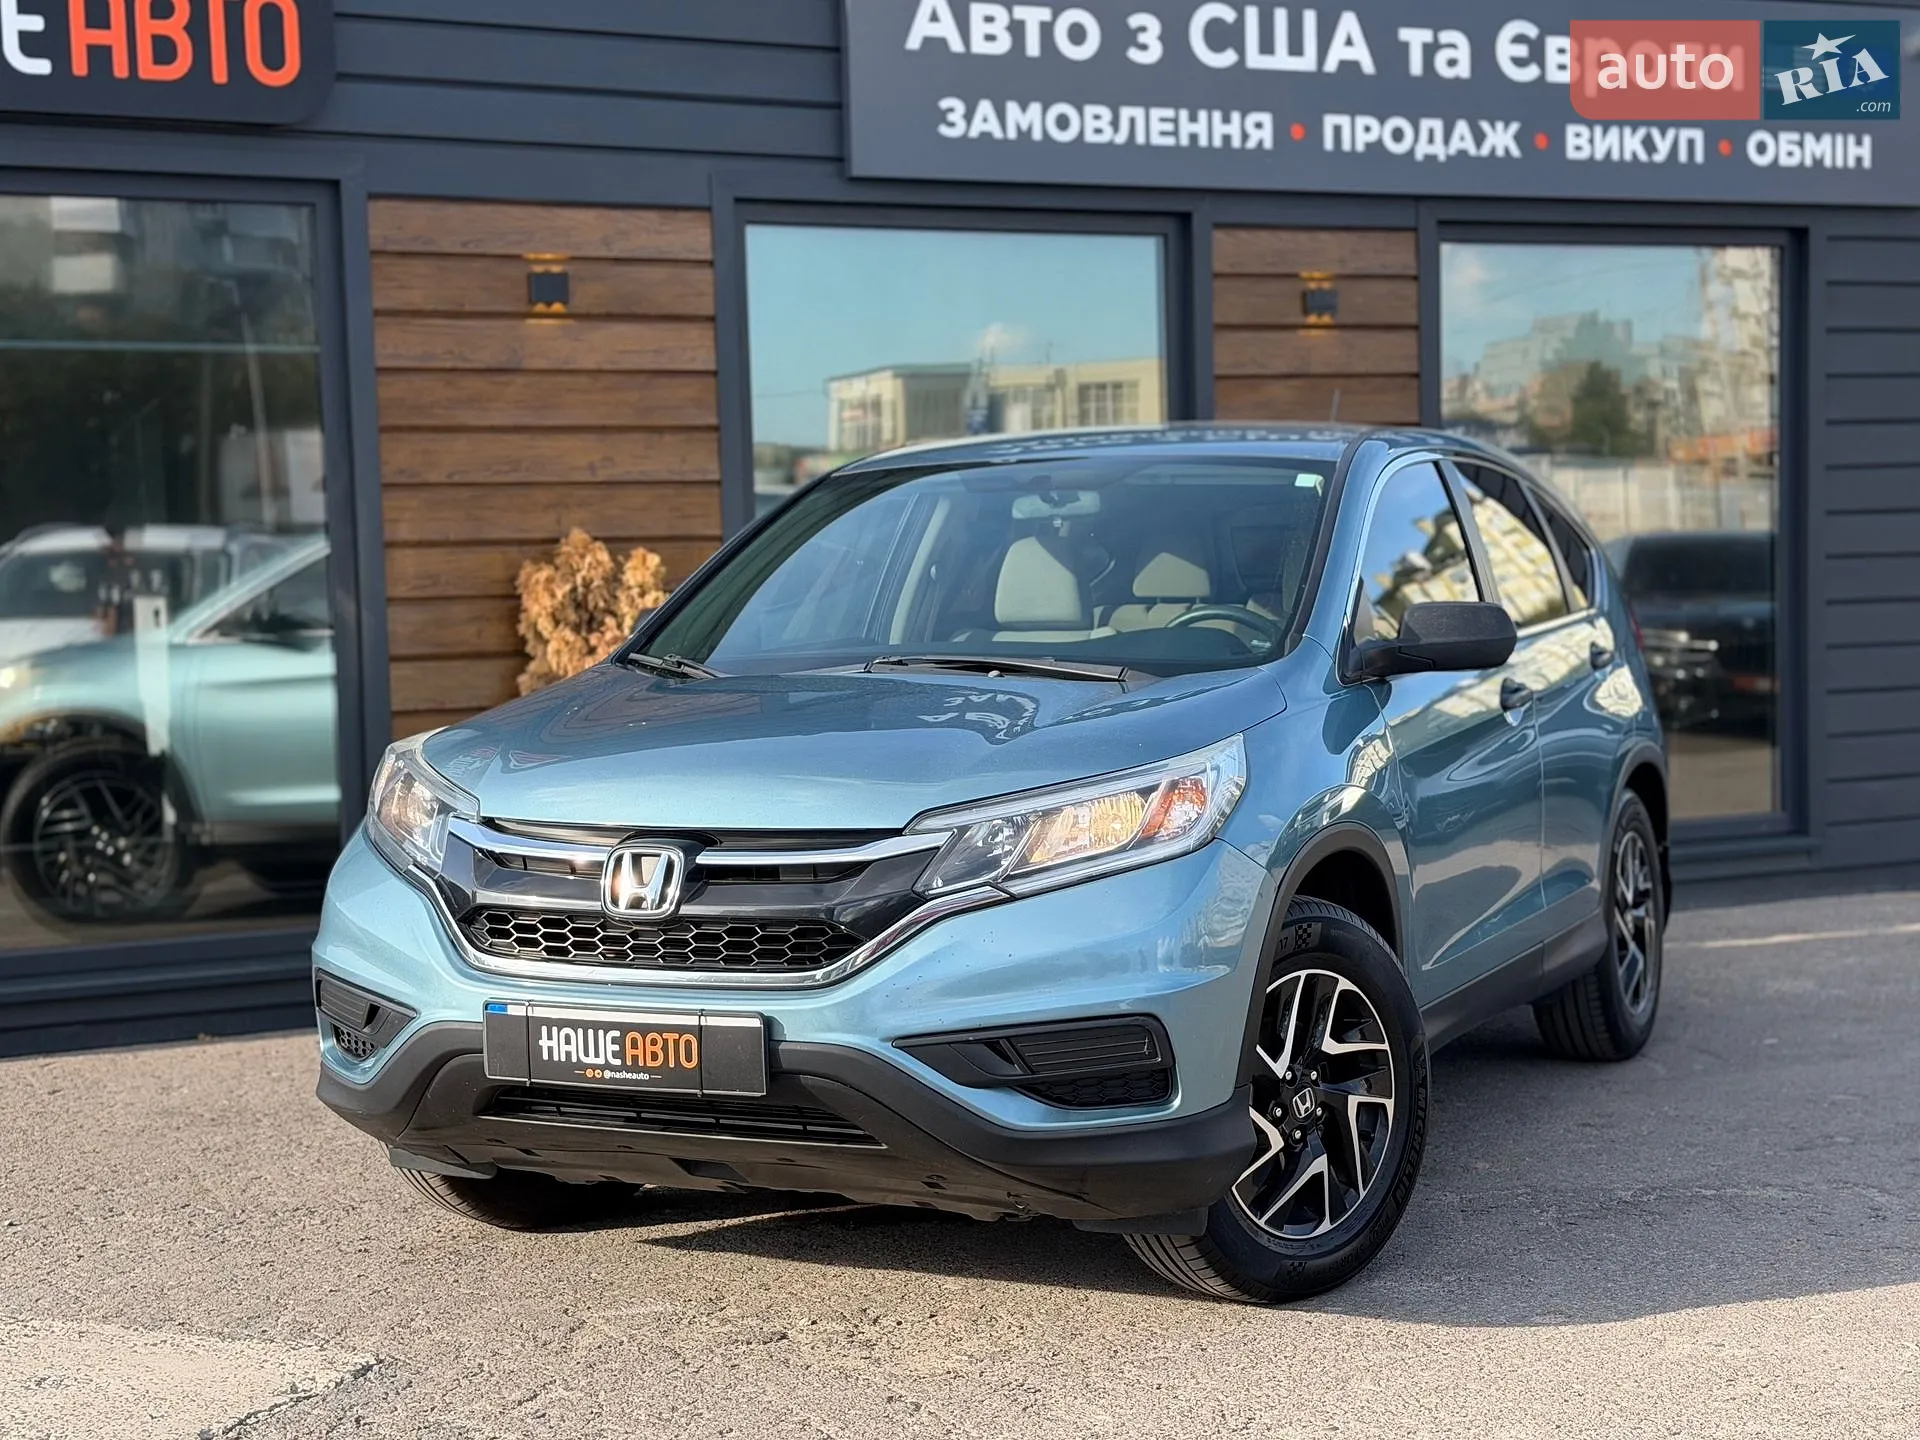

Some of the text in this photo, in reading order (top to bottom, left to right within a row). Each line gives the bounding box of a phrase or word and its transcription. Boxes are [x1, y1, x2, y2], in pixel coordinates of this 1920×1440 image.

[904, 0, 1102, 62] Авто
[1125, 12, 1164, 65] з
[1188, 1, 1376, 75] США
[1397, 27, 1472, 79] та
[937, 96, 1873, 169] ЗАМОВЛЕННЯ ПРОДАЖ ВИКУП ОБМІН
[538, 1024, 699, 1070] НАШЕ АВТО
[603, 1068, 650, 1081] @nasheauto
[1393, 1085, 1428, 1207] MICHELIN
